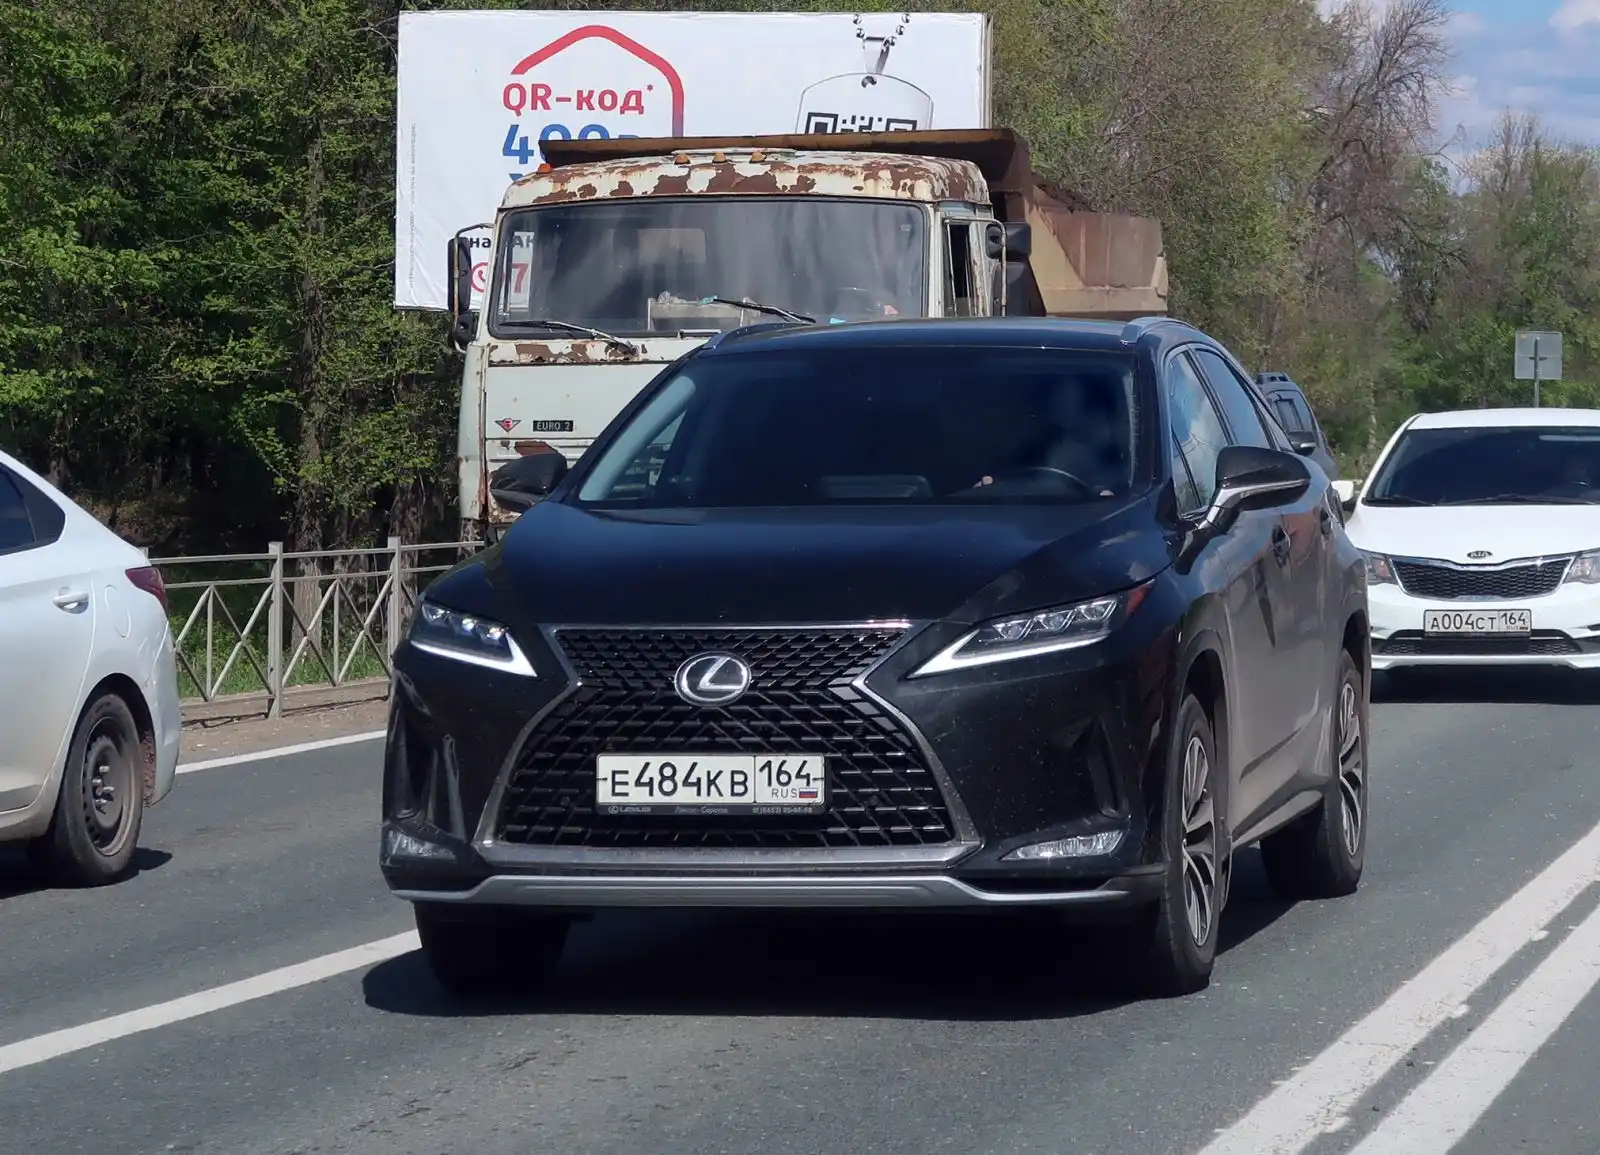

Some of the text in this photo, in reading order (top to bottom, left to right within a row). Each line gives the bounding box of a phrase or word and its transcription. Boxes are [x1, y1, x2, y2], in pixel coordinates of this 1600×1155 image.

[536, 421, 561, 430] EURO
[1430, 612, 1525, 630] А004СТ 164
[611, 759, 811, 797] Е484КВ 164
[771, 788, 798, 798] RUS
